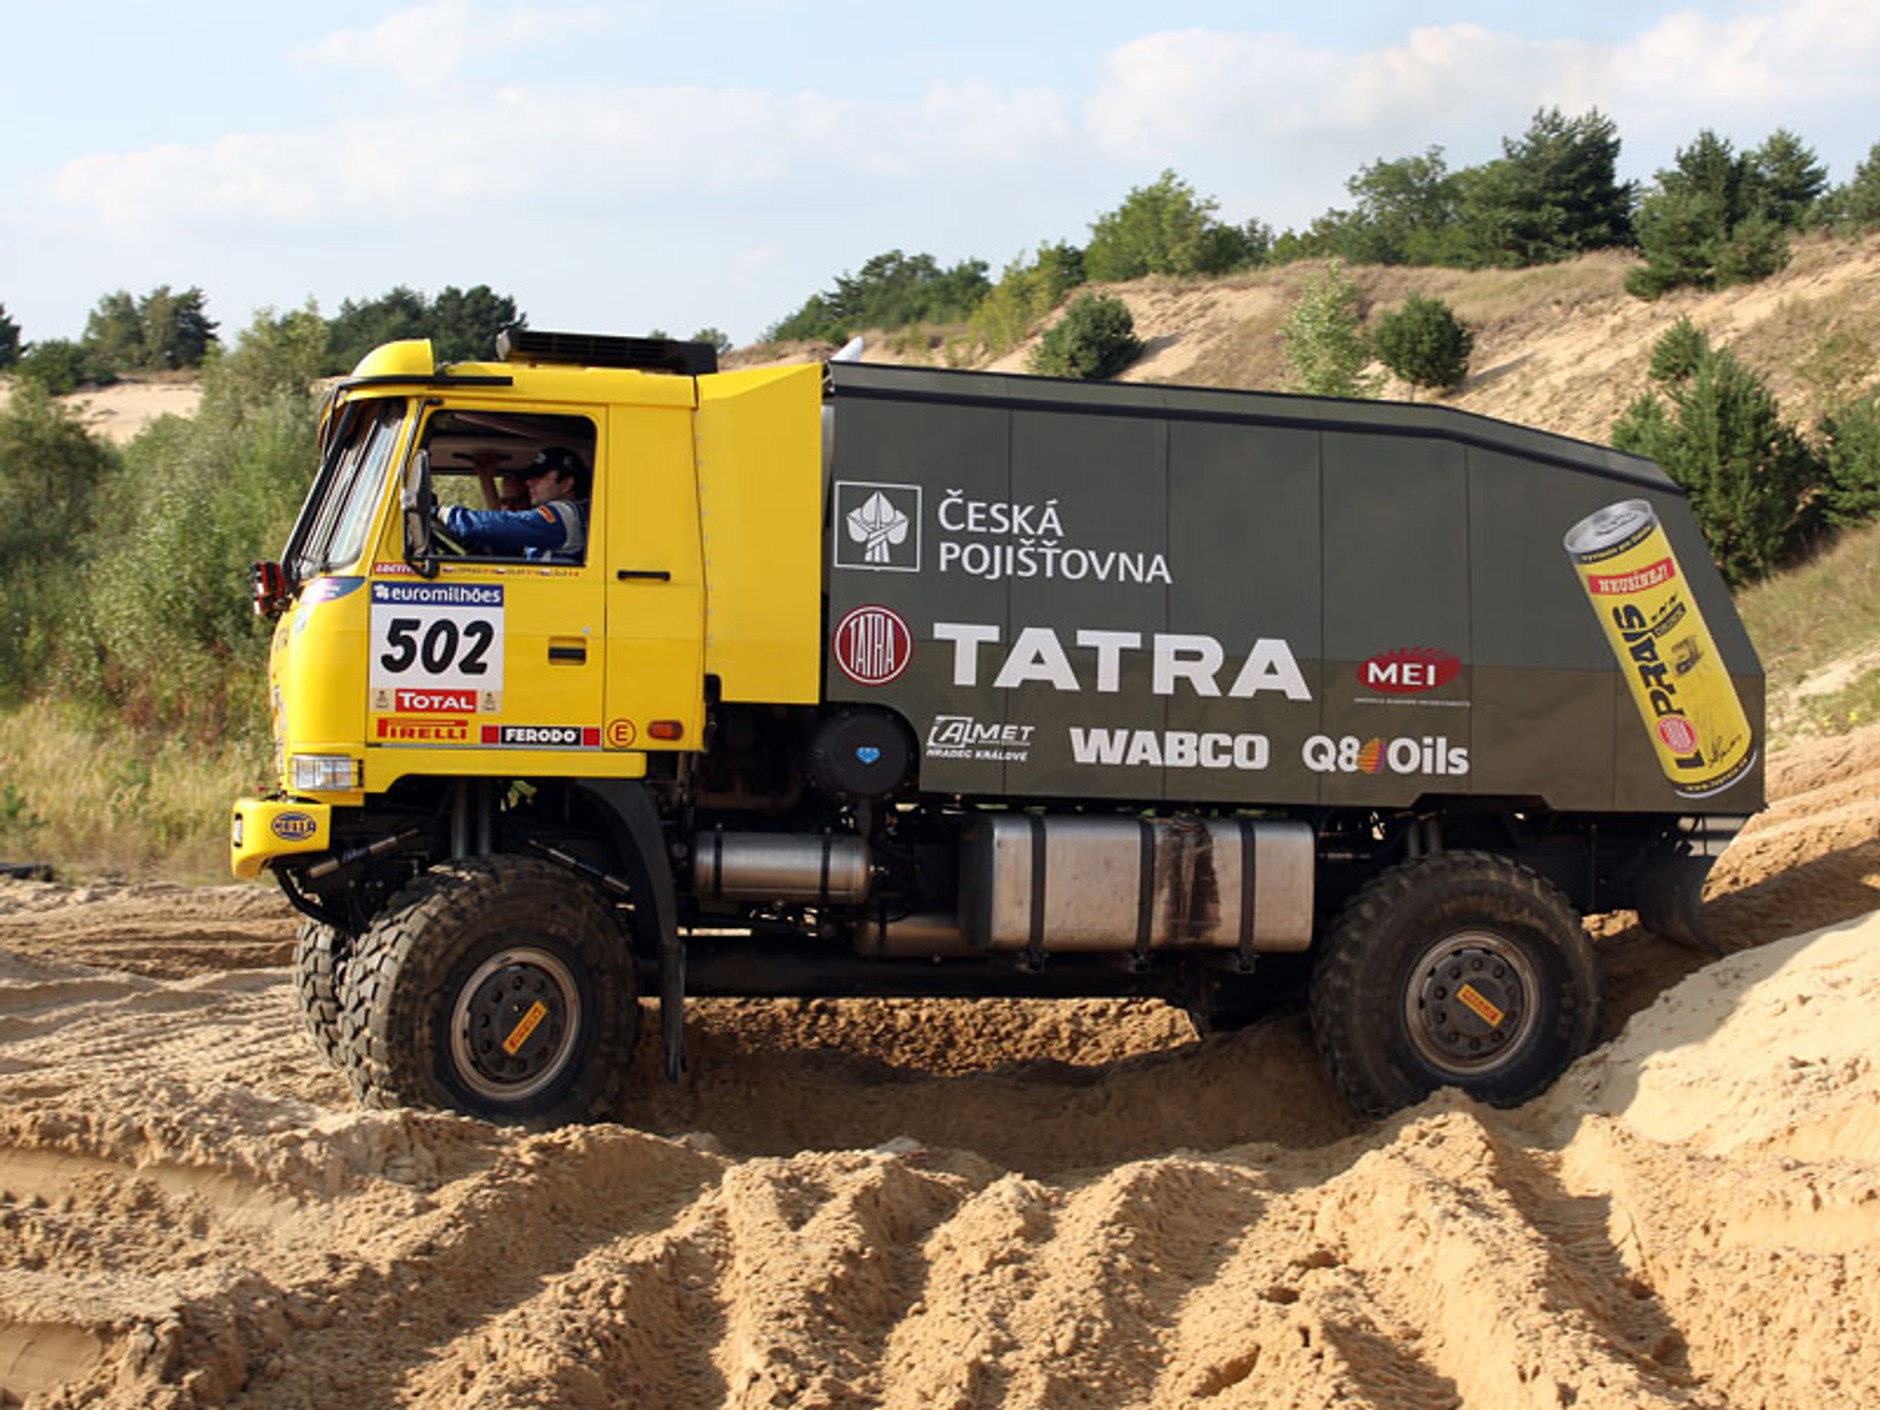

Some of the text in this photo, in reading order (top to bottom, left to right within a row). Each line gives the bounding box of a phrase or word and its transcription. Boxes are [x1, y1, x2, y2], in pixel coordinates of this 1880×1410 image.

[938, 488, 1064, 537] ČESKÁ
[939, 537, 1173, 585] POJIŠŤOVNA
[391, 585, 501, 603] euromilhões
[380, 618, 495, 675] 502
[849, 613, 895, 678] TATRA
[933, 622, 1313, 701] TATRA
[1367, 662, 1436, 686] MEI
[397, 692, 474, 709] TOTAL
[377, 717, 468, 739] PIRELLI
[505, 728, 577, 743] FERODO
[1068, 726, 1270, 769] WABCO
[1302, 735, 1470, 775] Q8 Oils
